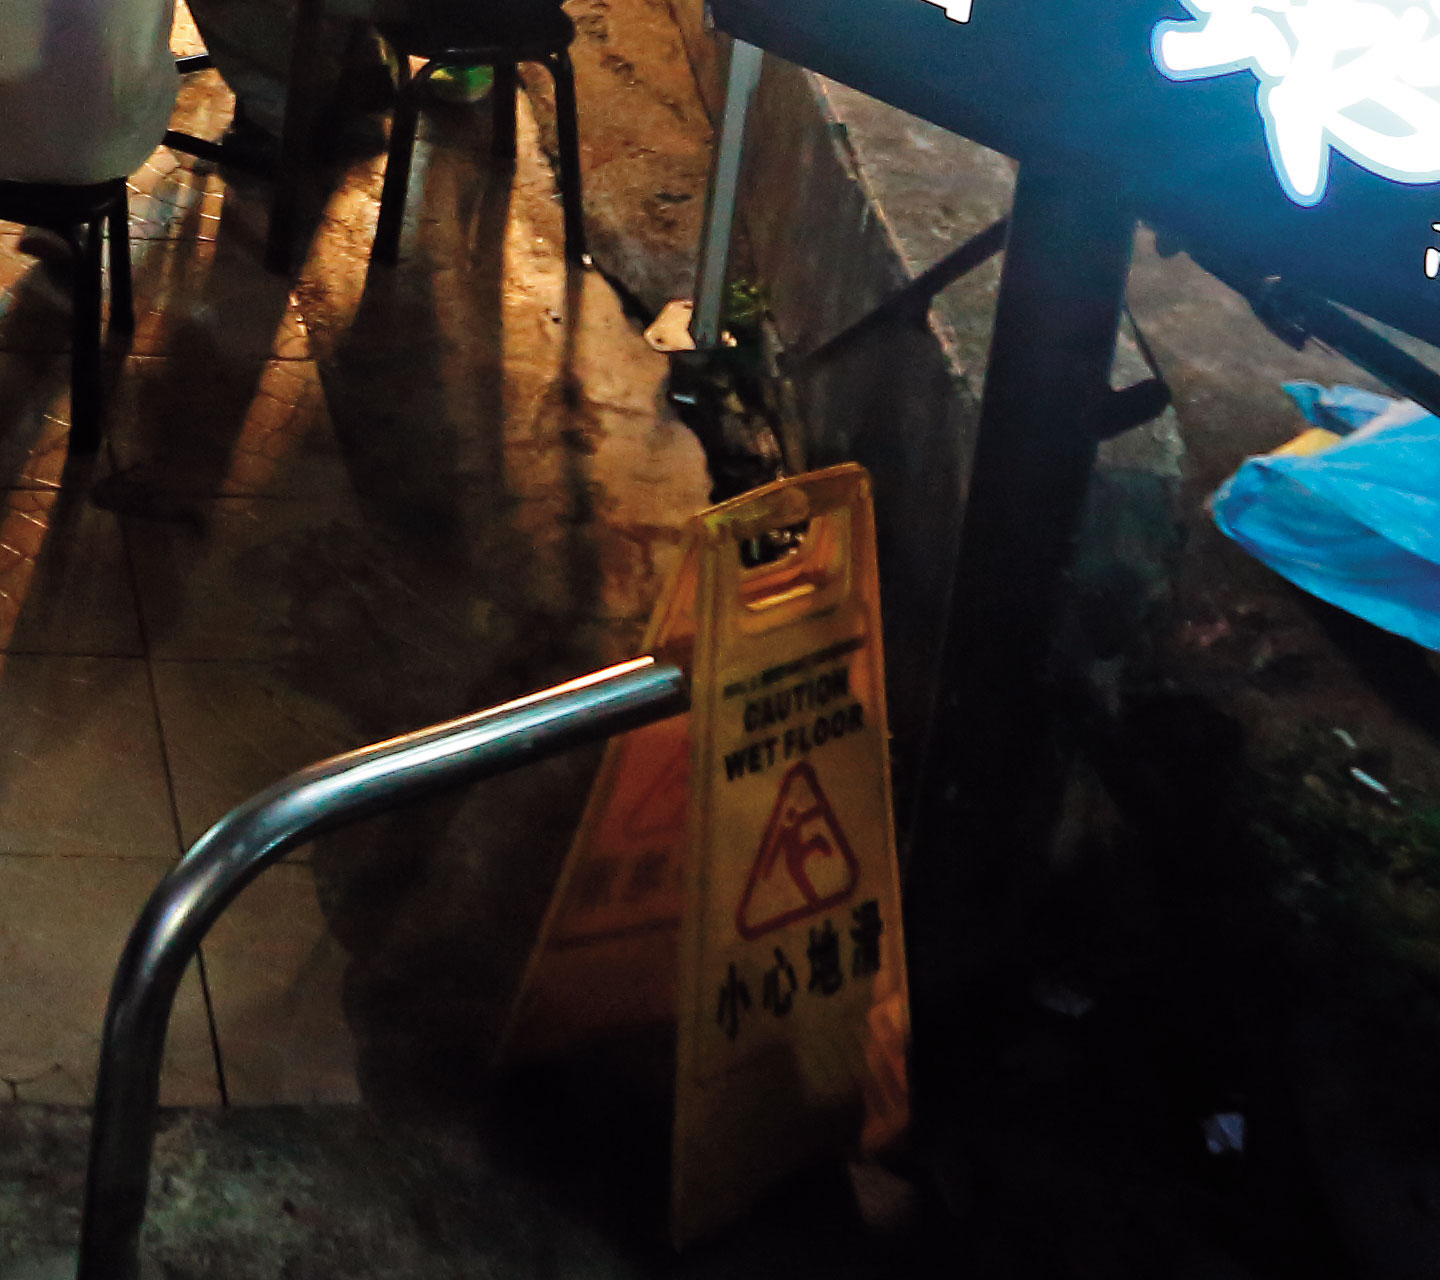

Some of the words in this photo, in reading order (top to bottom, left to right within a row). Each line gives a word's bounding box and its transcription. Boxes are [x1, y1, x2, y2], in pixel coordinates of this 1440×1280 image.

[743, 666, 848, 732] CAUTION
[724, 736, 778, 782] WET
[783, 702, 865, 760] FLOOR
[717, 899, 883, 1040] 小心地滑
